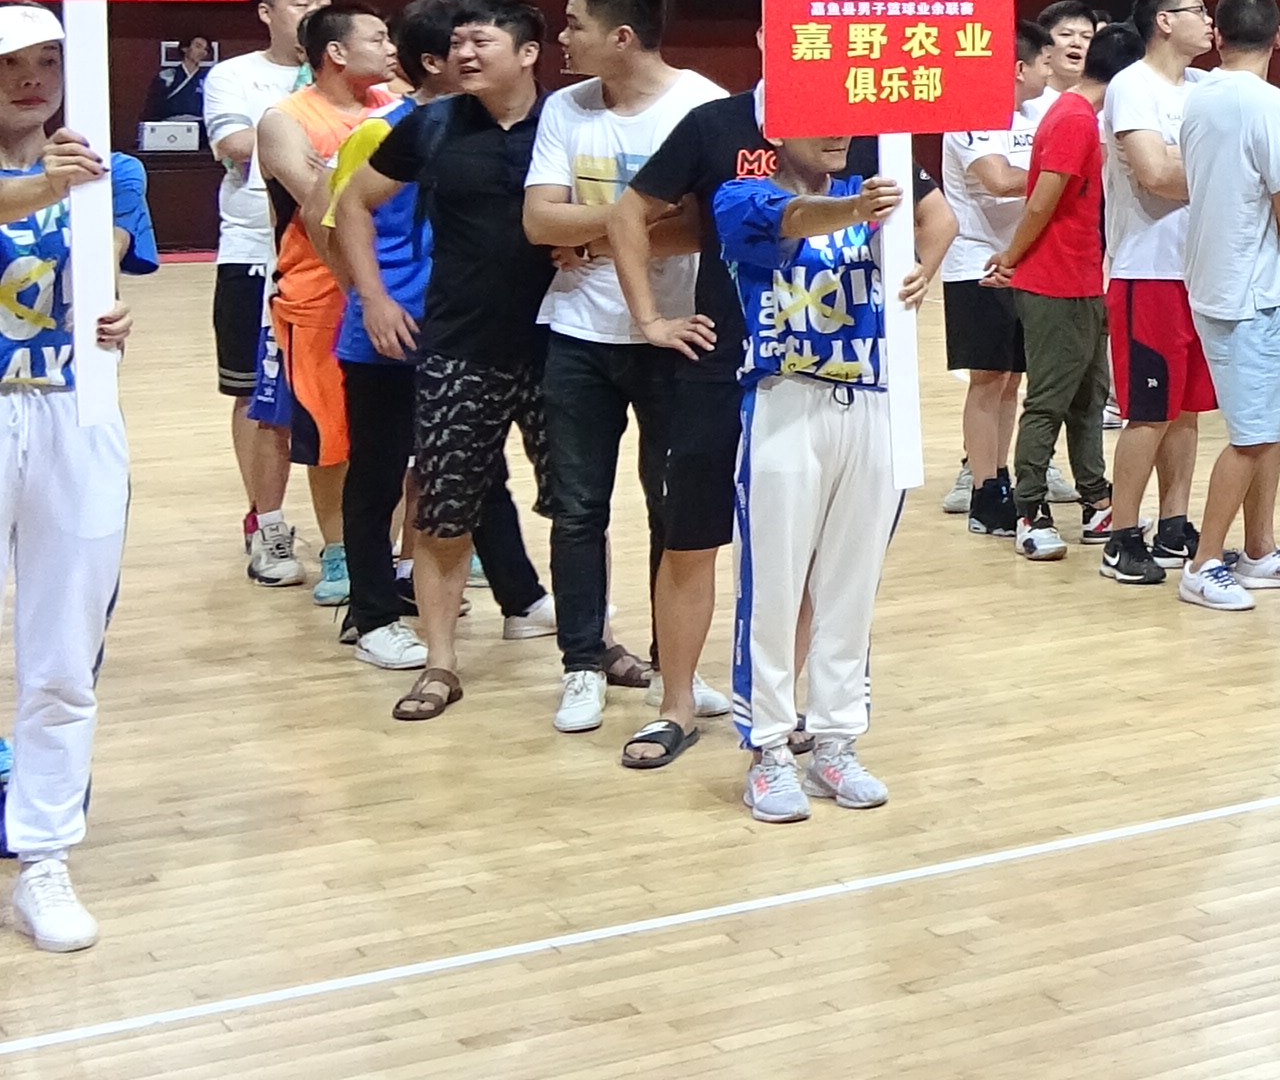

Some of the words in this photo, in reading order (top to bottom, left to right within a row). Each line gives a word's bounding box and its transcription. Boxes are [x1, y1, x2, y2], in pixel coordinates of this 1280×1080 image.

[791, 22, 993, 61] 嘉野农业
[845, 65, 942, 104] 俱乐部
